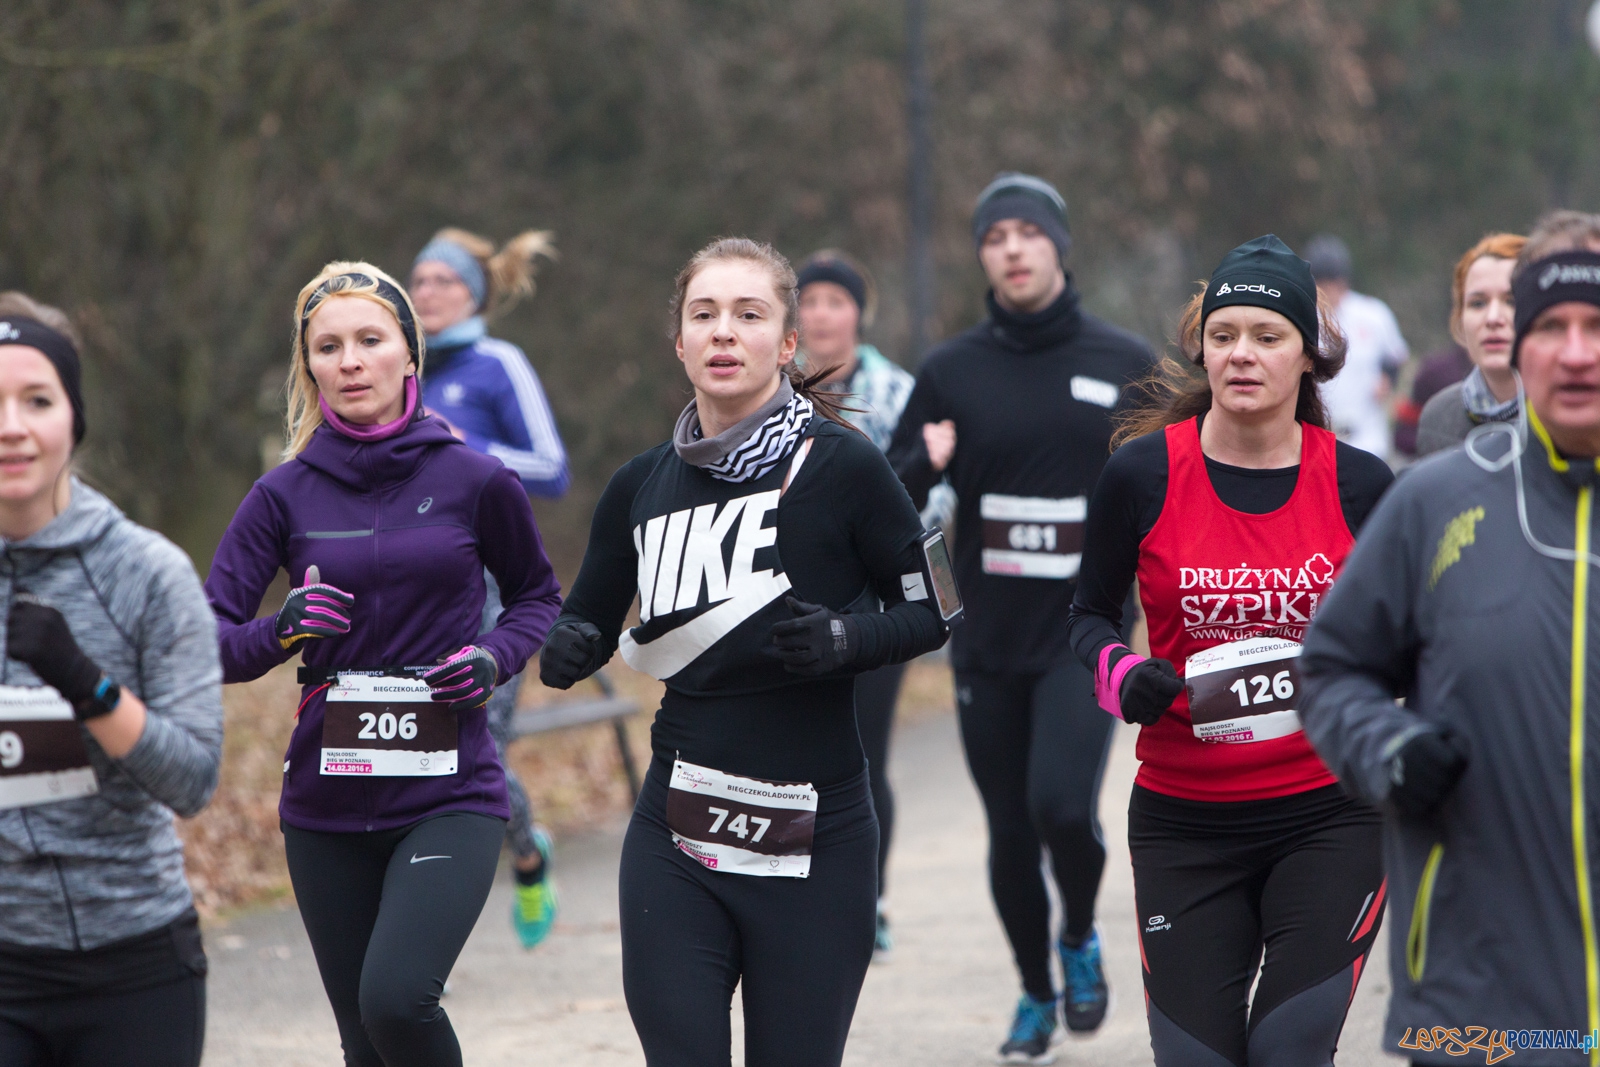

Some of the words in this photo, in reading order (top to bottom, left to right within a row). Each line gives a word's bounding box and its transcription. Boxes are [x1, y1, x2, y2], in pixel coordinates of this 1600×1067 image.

[1234, 284, 1281, 298] odlo
[1008, 524, 1057, 551] 681
[633, 489, 782, 624] NIKE
[1179, 562, 1314, 590] DRUŻYNA
[1229, 670, 1295, 707] 126
[358, 712, 418, 740] 206
[727, 784, 811, 801] BIEGCZEKOLADOWY.PL
[708, 806, 772, 843] 747
